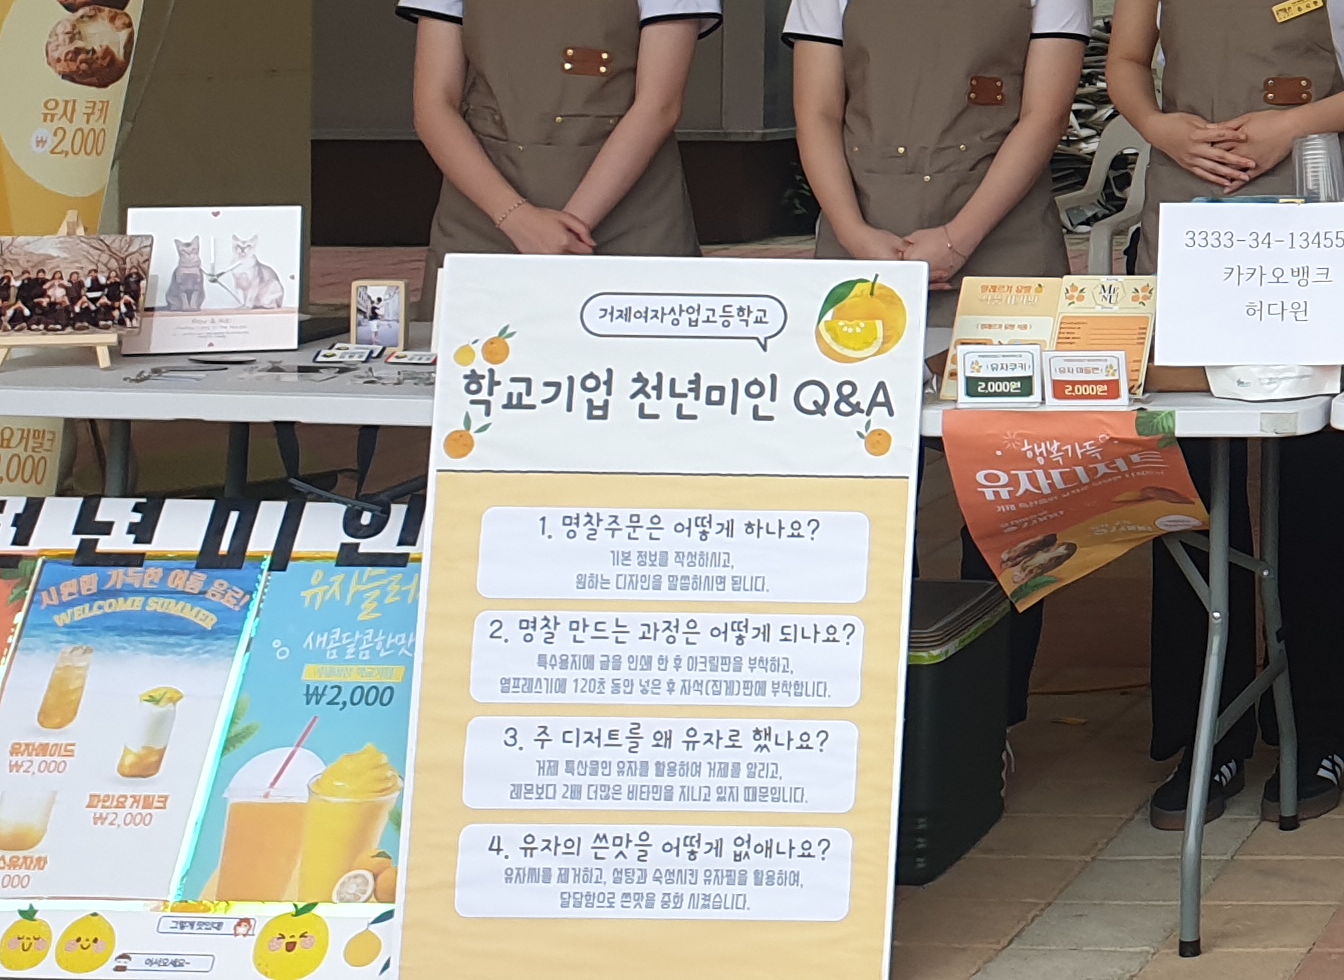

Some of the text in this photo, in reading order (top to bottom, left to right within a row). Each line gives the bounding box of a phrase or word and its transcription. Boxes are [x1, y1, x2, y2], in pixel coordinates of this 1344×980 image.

[42, 98, 111, 125] 유자 쿠키
[1222, 265, 1334, 287] 카카오뱅크
[596, 303, 771, 330] 거제여자상업고등학교
[1244, 299, 1309, 322] 허다원
[990, 362, 1028, 372] 유자쿠키
[462, 367, 895, 422] 학교기업 천년미인 Q&A
[977, 381, 1022, 394] 2,000원
[1064, 384, 1108, 396] 2,000원
[1020, 438, 1104, 466] 행복가득
[974, 451, 1170, 501] 유자디저트
[539, 511, 821, 542] 1. 명찰주문은 어떻게 하나요?
[301, 567, 421, 621] 유자슬러
[53, 596, 219, 631] WELCOME SUMMER
[489, 615, 856, 647] 2. 명찰 만드는 과정은 어떻게 되나요?
[303, 684, 396, 711] ₩2,000
[503, 722, 829, 754] 3. 주 디저트를 왜 유자로 했나요?
[8, 759, 67, 776] ₩2,000
[92, 812, 154, 828] ₩2,000
[487, 830, 831, 863] 4. 유자의 쓴맛을 어떻게 없애나요?
